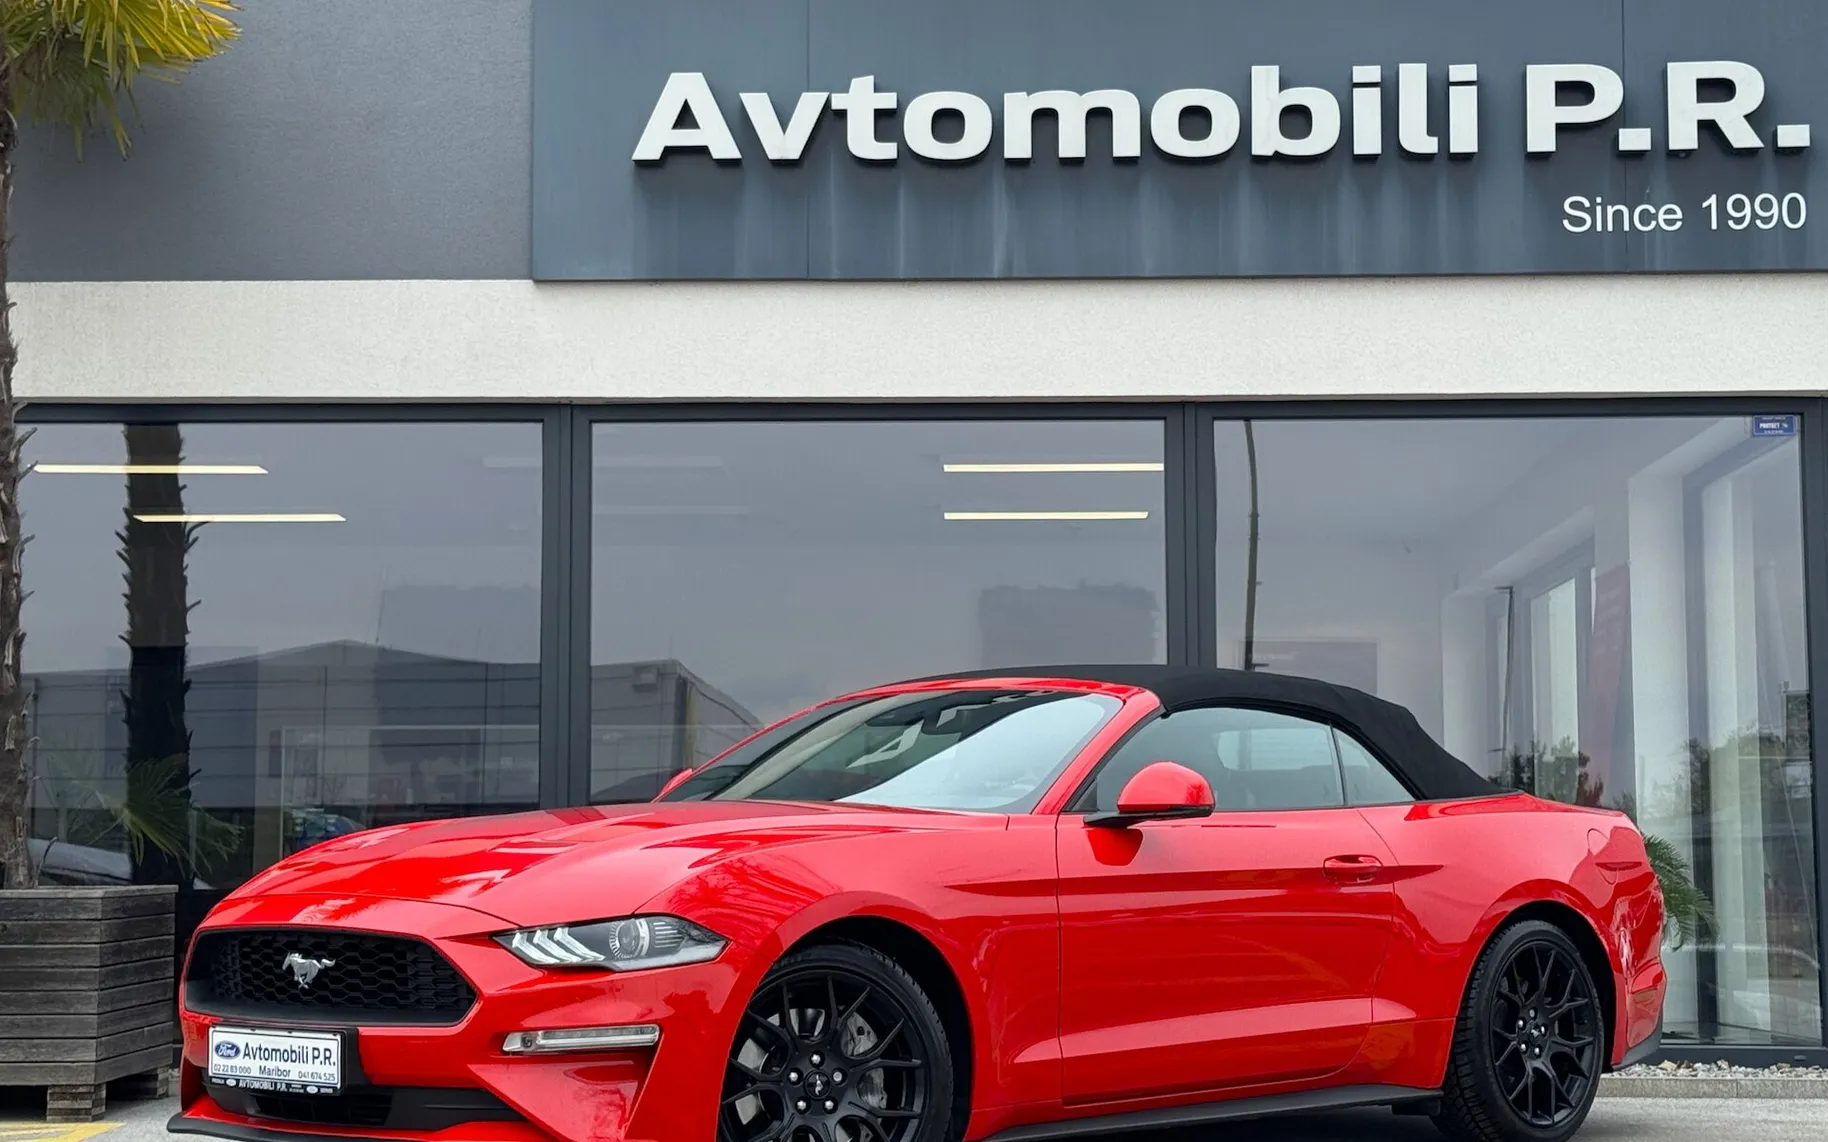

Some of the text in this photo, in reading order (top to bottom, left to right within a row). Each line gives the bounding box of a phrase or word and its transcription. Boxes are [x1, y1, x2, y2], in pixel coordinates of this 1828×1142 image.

[631, 60, 1811, 162] Avtomobili P.R.
[1562, 192, 1807, 233] Since 1990
[242, 1042, 336, 1067] Avtomobili P.R.
[214, 1064, 221, 1072] 02
[222, 1065, 229, 1073] 22
[239, 1066, 252, 1075] 000
[258, 1065, 291, 1078] Maribor
[298, 1071, 310, 1080] 041
[238, 1080, 275, 1090] AVTOMOBILI
